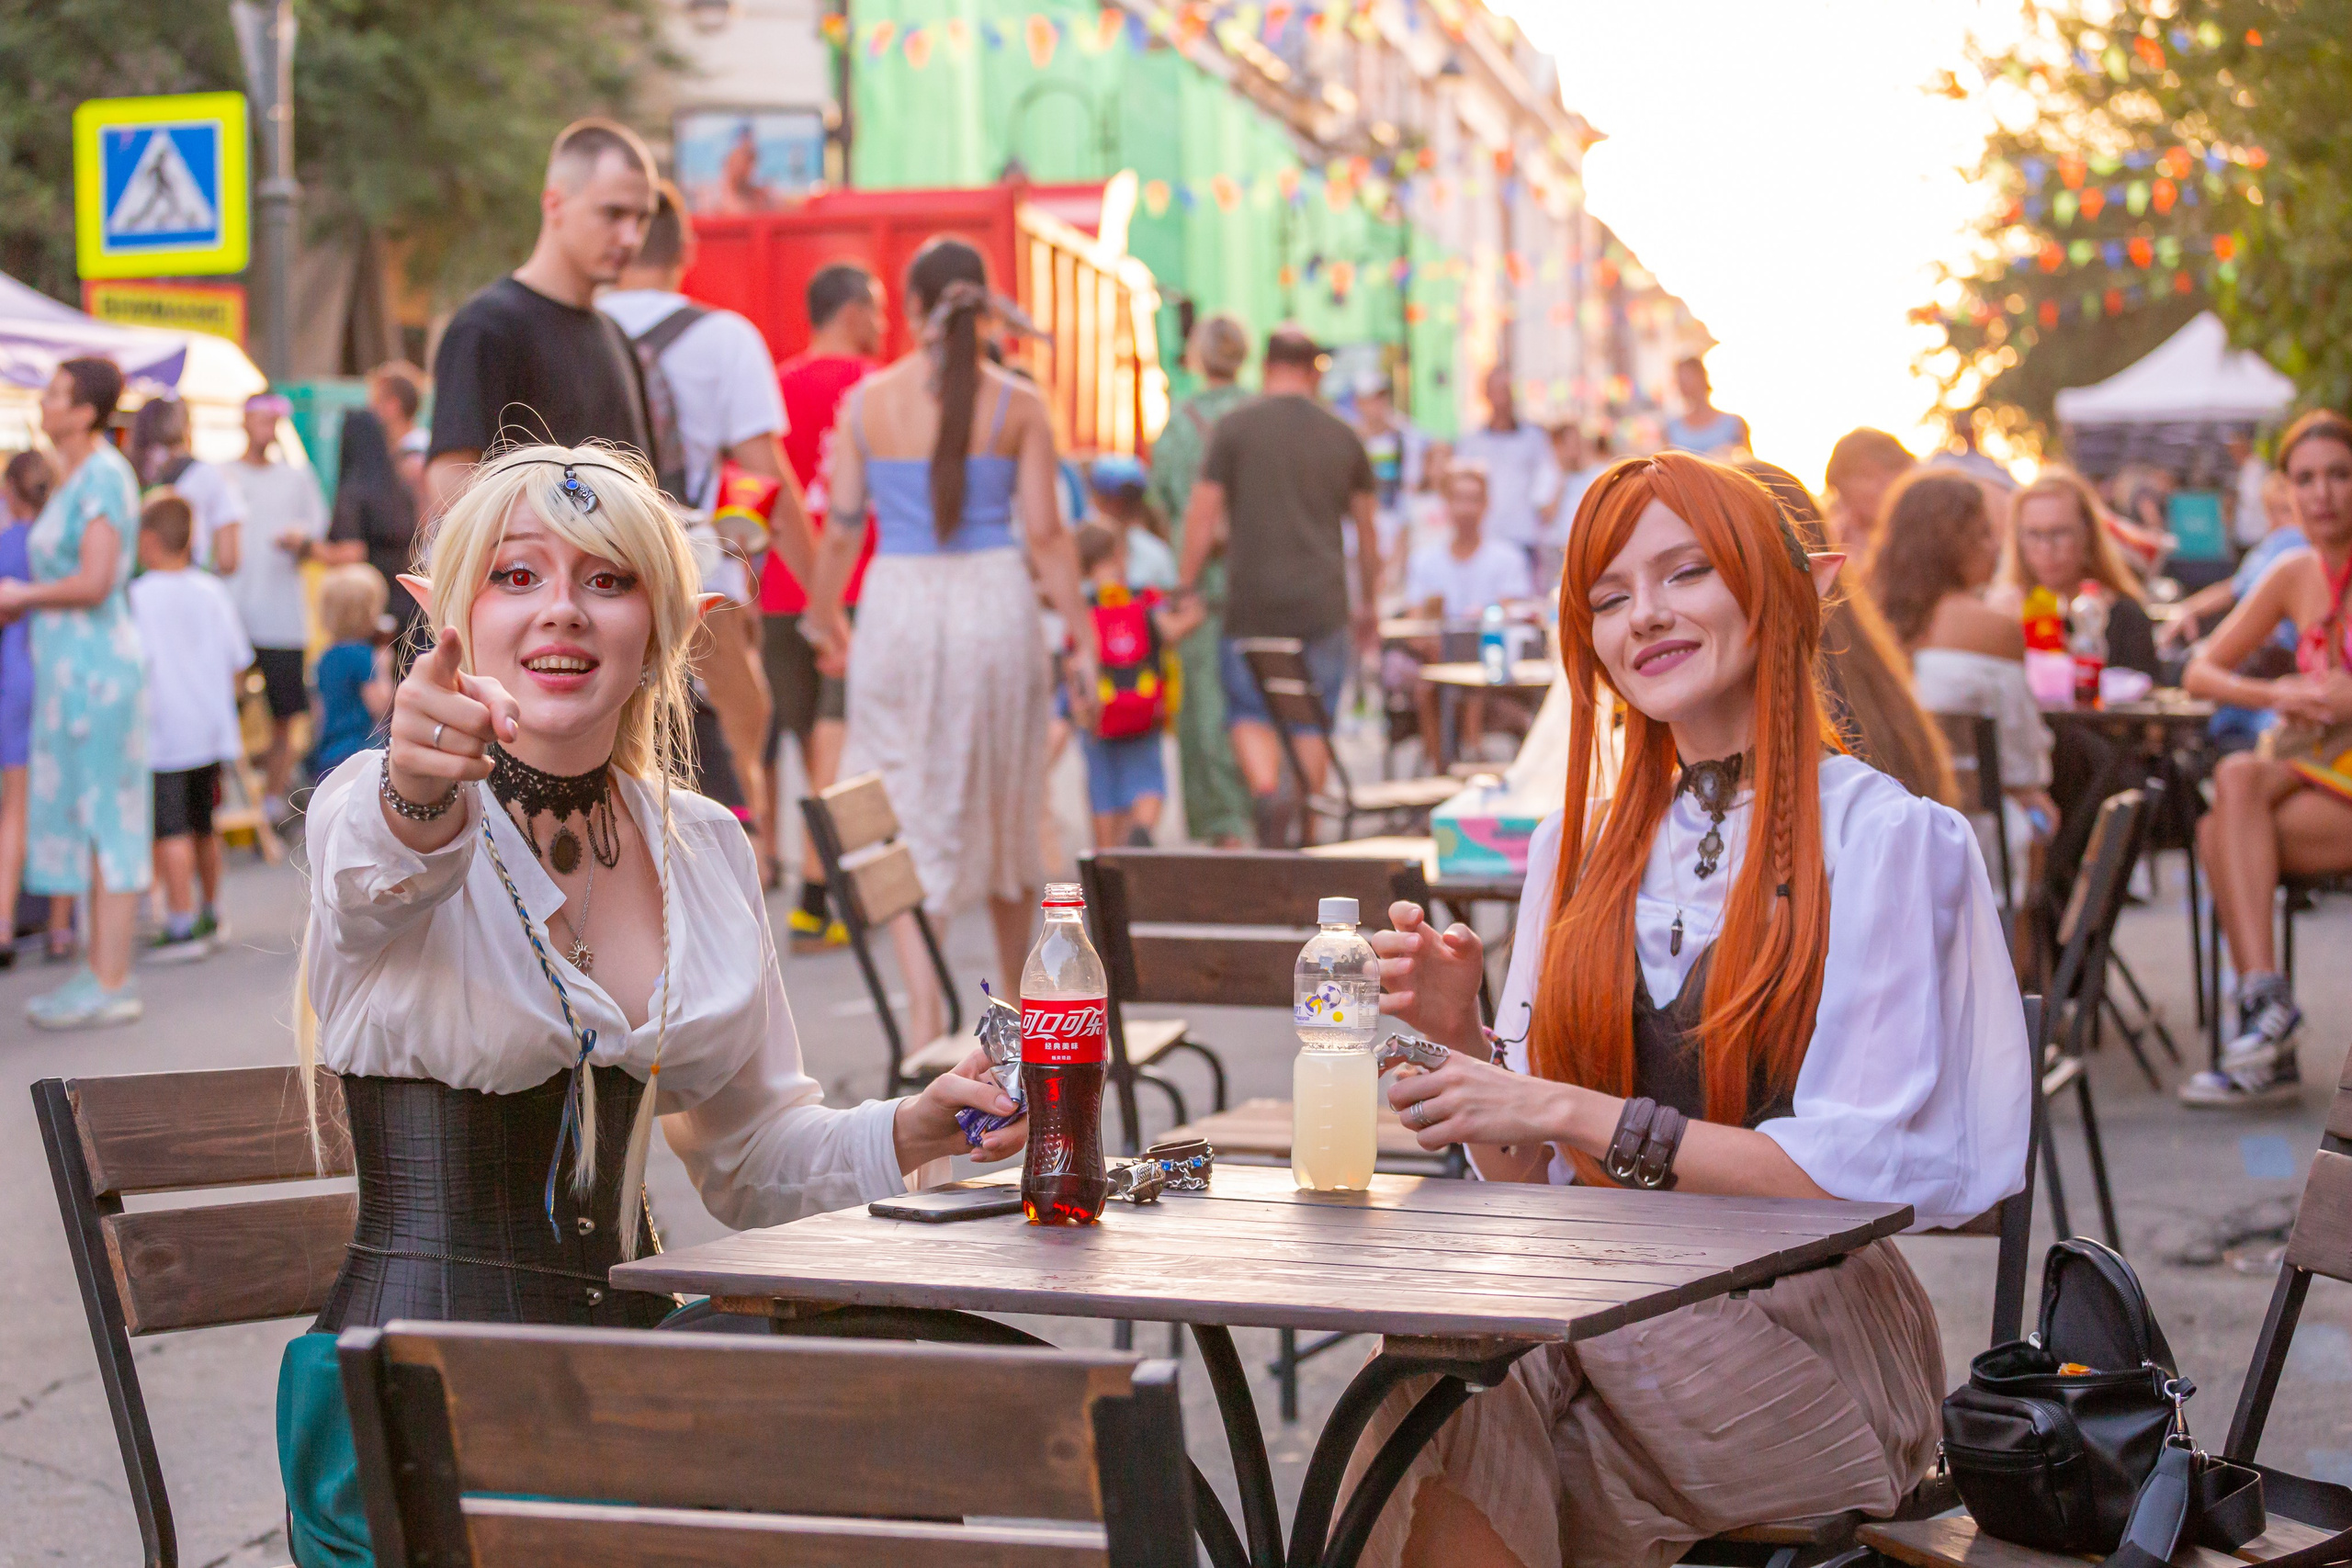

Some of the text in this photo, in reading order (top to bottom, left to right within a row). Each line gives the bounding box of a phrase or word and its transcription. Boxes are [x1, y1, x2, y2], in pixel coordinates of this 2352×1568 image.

[1023, 1007, 1105, 1040] 可口可乐
[1045, 1042, 1079, 1050] 经典美味
